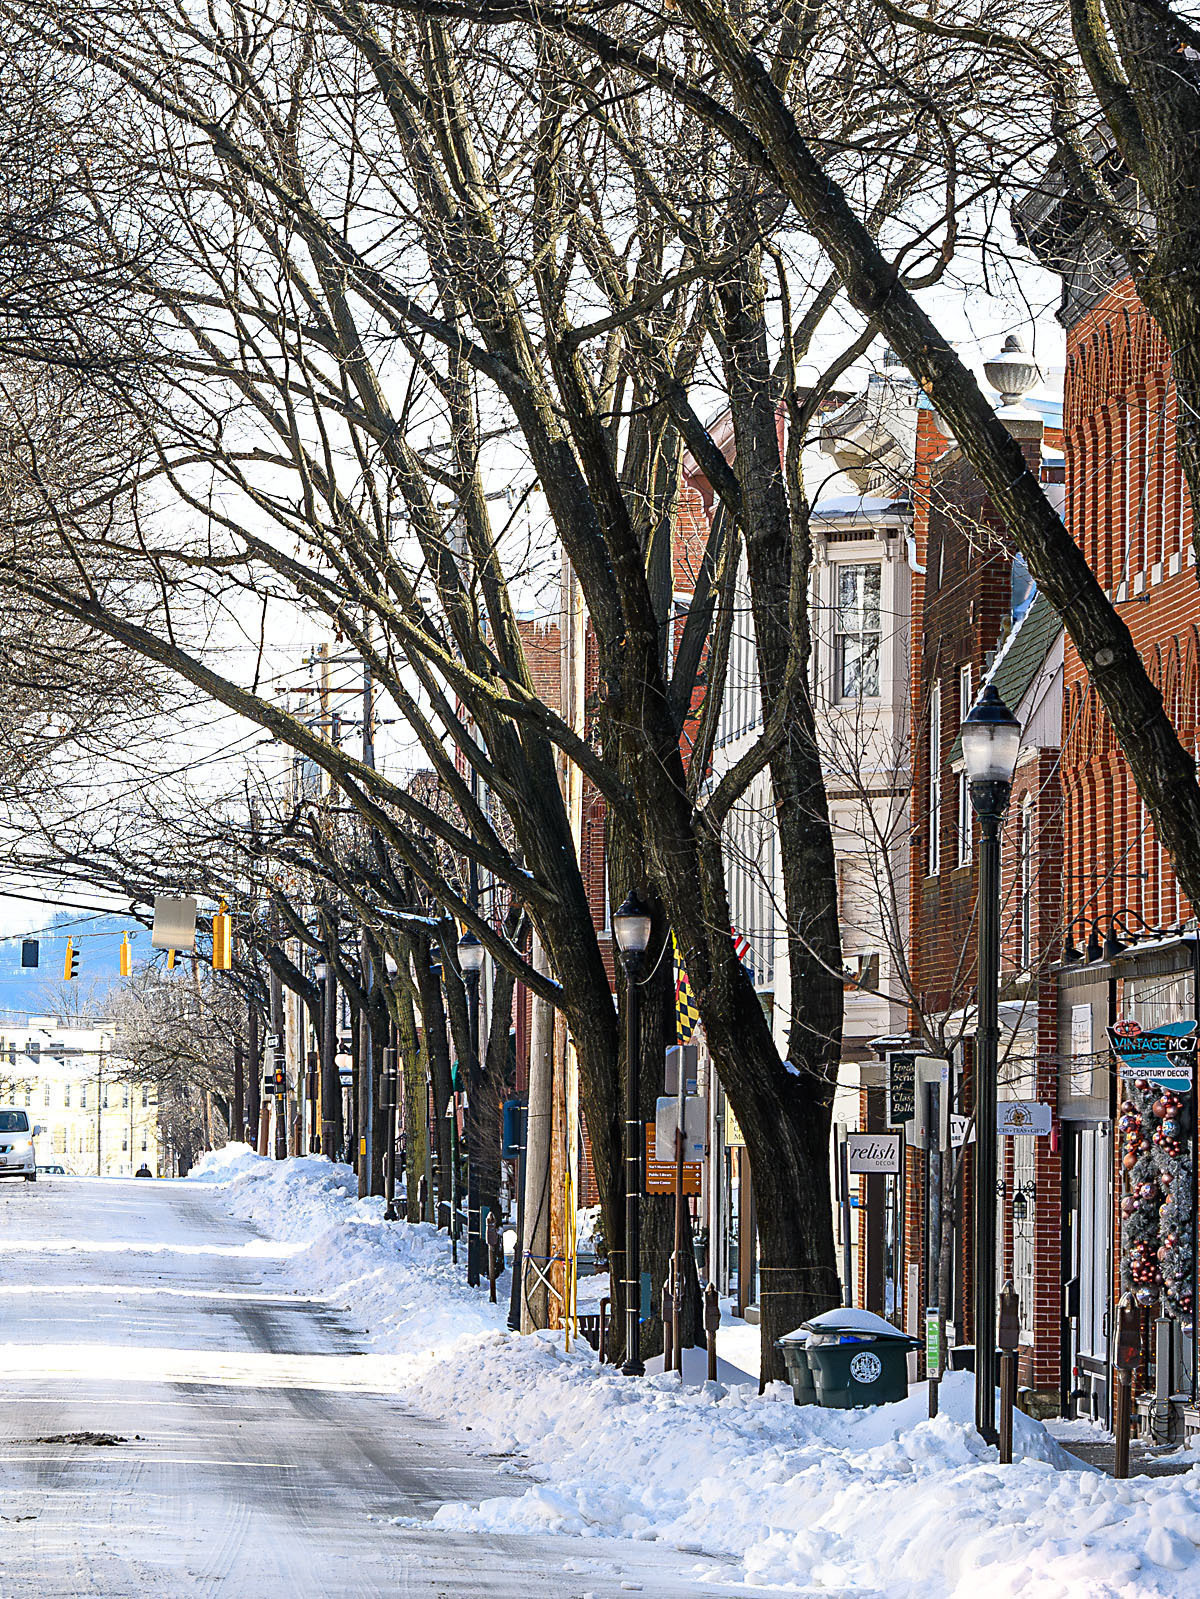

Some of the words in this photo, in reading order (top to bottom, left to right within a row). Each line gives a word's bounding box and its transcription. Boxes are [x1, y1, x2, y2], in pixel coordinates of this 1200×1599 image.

[1114, 1037, 1167, 1051] VINTAGE
[1168, 1038, 1188, 1051] MC
[1122, 1069, 1166, 1077] MID-CENTURY
[1167, 1069, 1189, 1077] DECOR
[851, 1142, 896, 1160] relish
